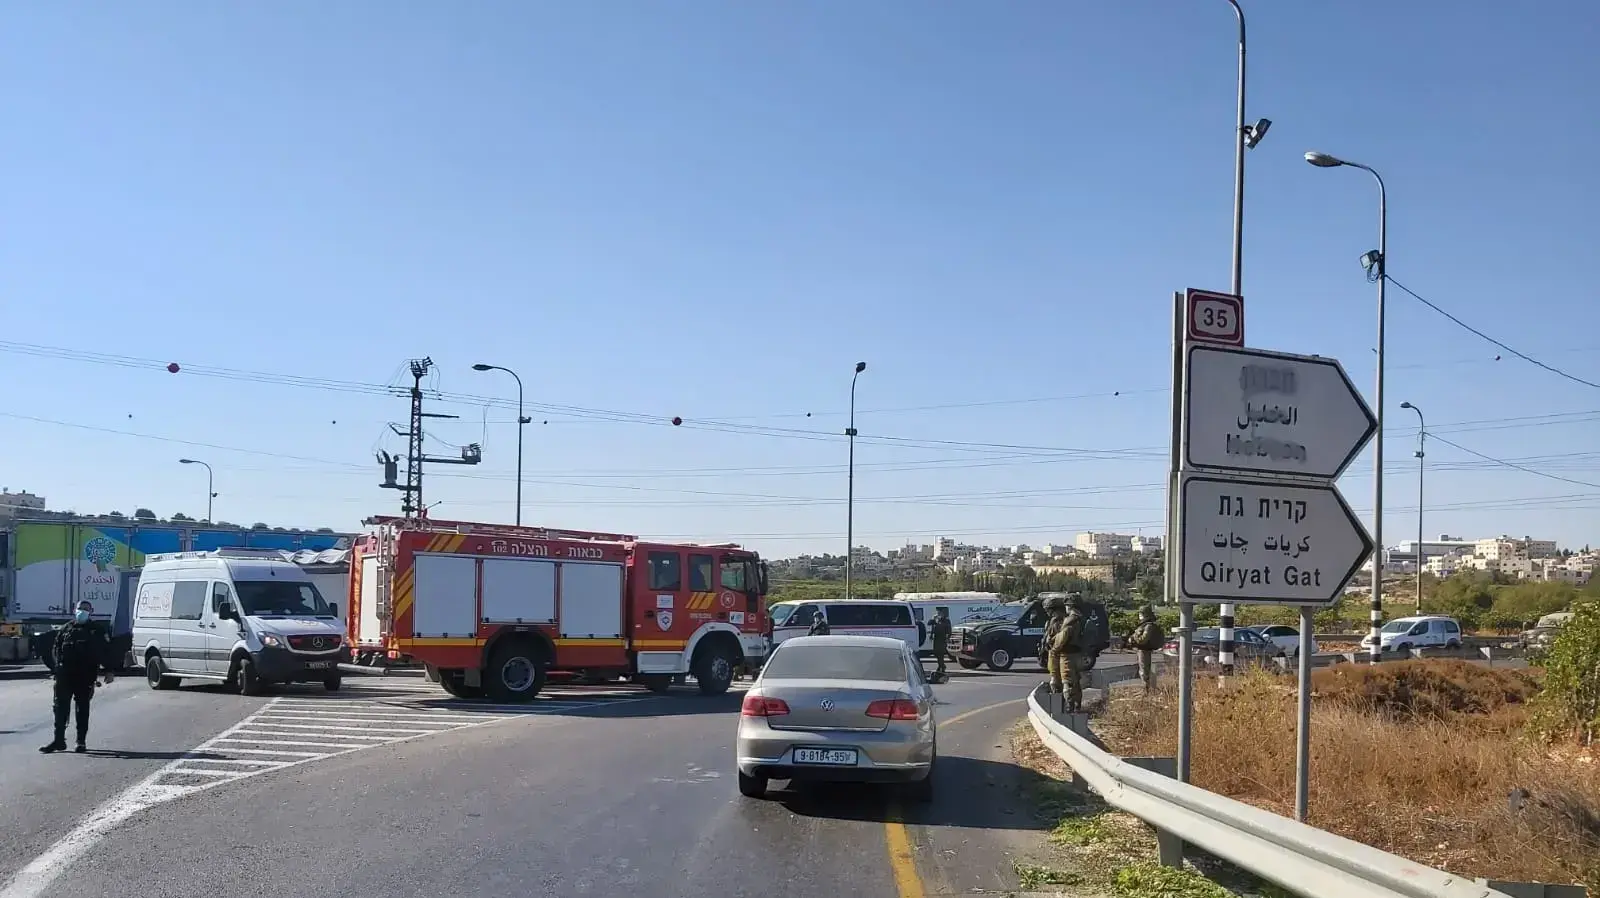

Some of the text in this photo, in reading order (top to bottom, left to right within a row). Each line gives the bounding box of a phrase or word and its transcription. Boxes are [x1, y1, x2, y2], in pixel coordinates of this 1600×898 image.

[1203, 307, 1228, 328] 35
[1218, 495, 1307, 524] קרית גת
[511, 542, 548, 557] והצלה
[568, 546, 604, 559] כבאות
[1263, 534, 1311, 559] كريات
[1200, 561, 1321, 589] Qiryat Gat
